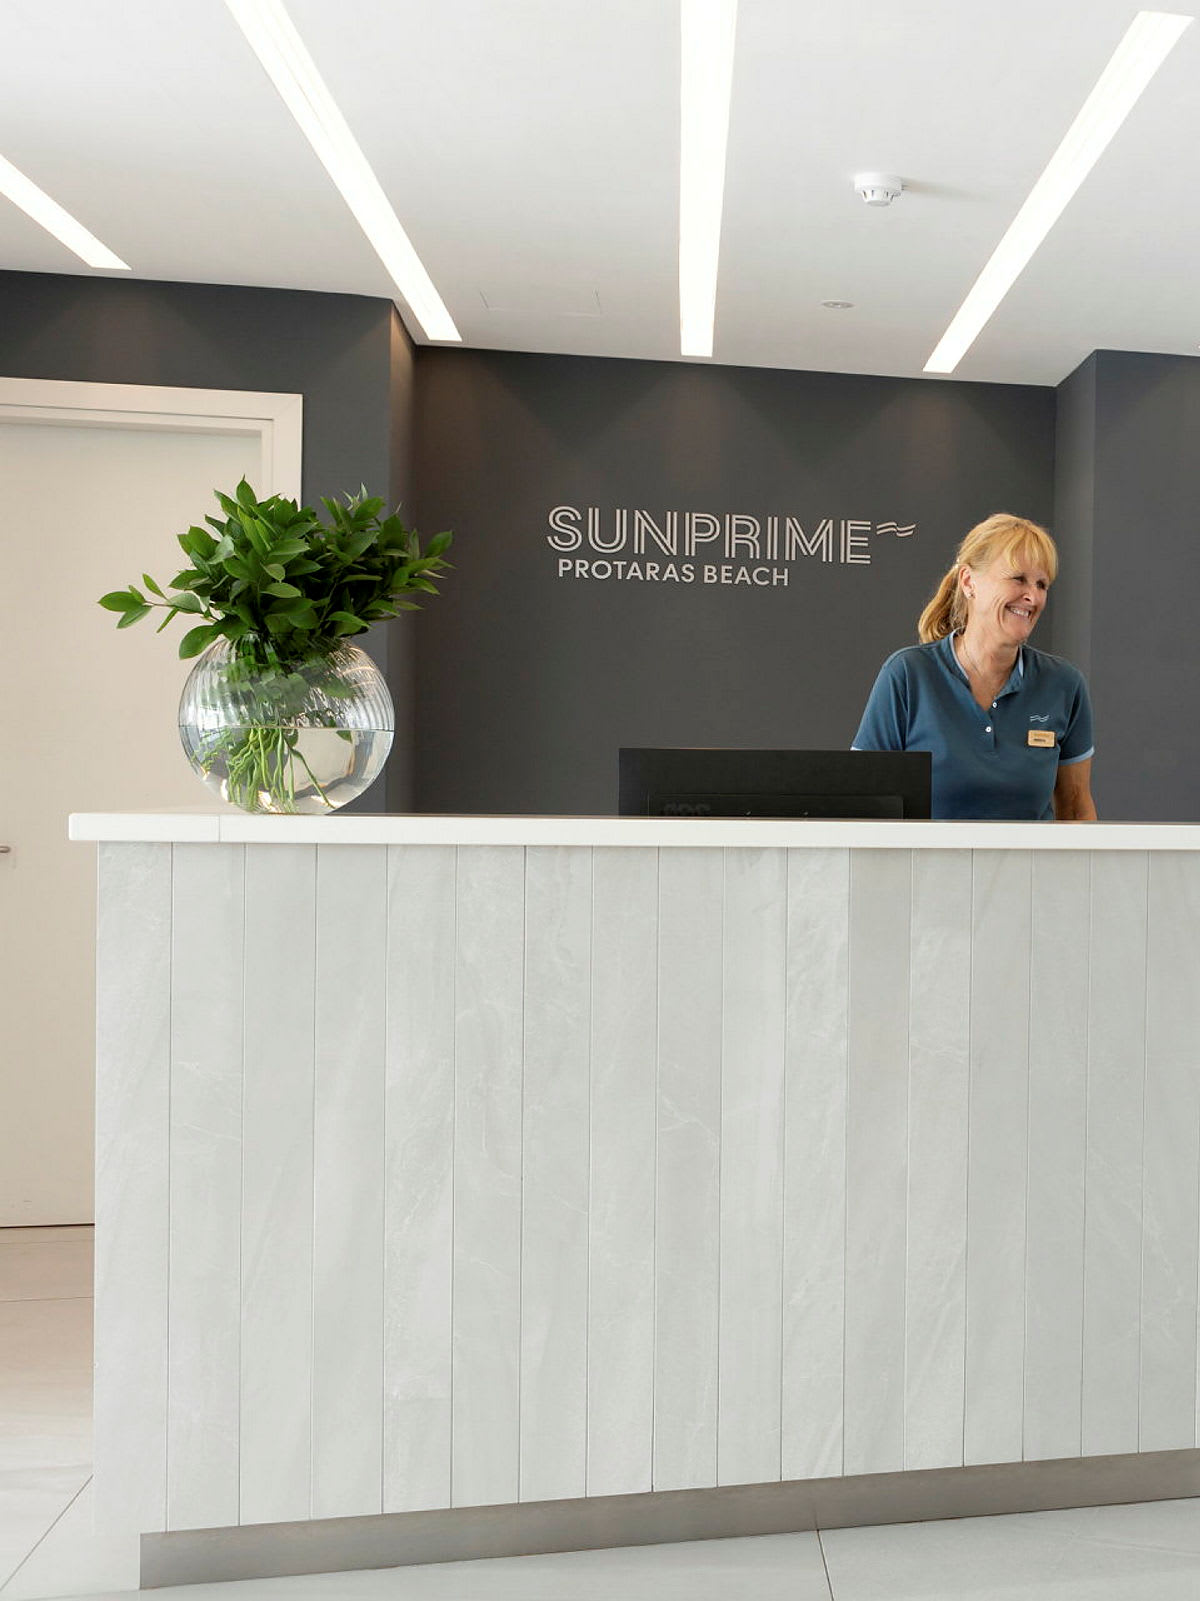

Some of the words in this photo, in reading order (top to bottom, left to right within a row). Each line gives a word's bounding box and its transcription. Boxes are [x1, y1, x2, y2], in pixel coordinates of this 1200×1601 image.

[547, 506, 871, 565] SUNPRIME
[557, 558, 696, 583] PROTARAS
[703, 566, 789, 586] BEACH
